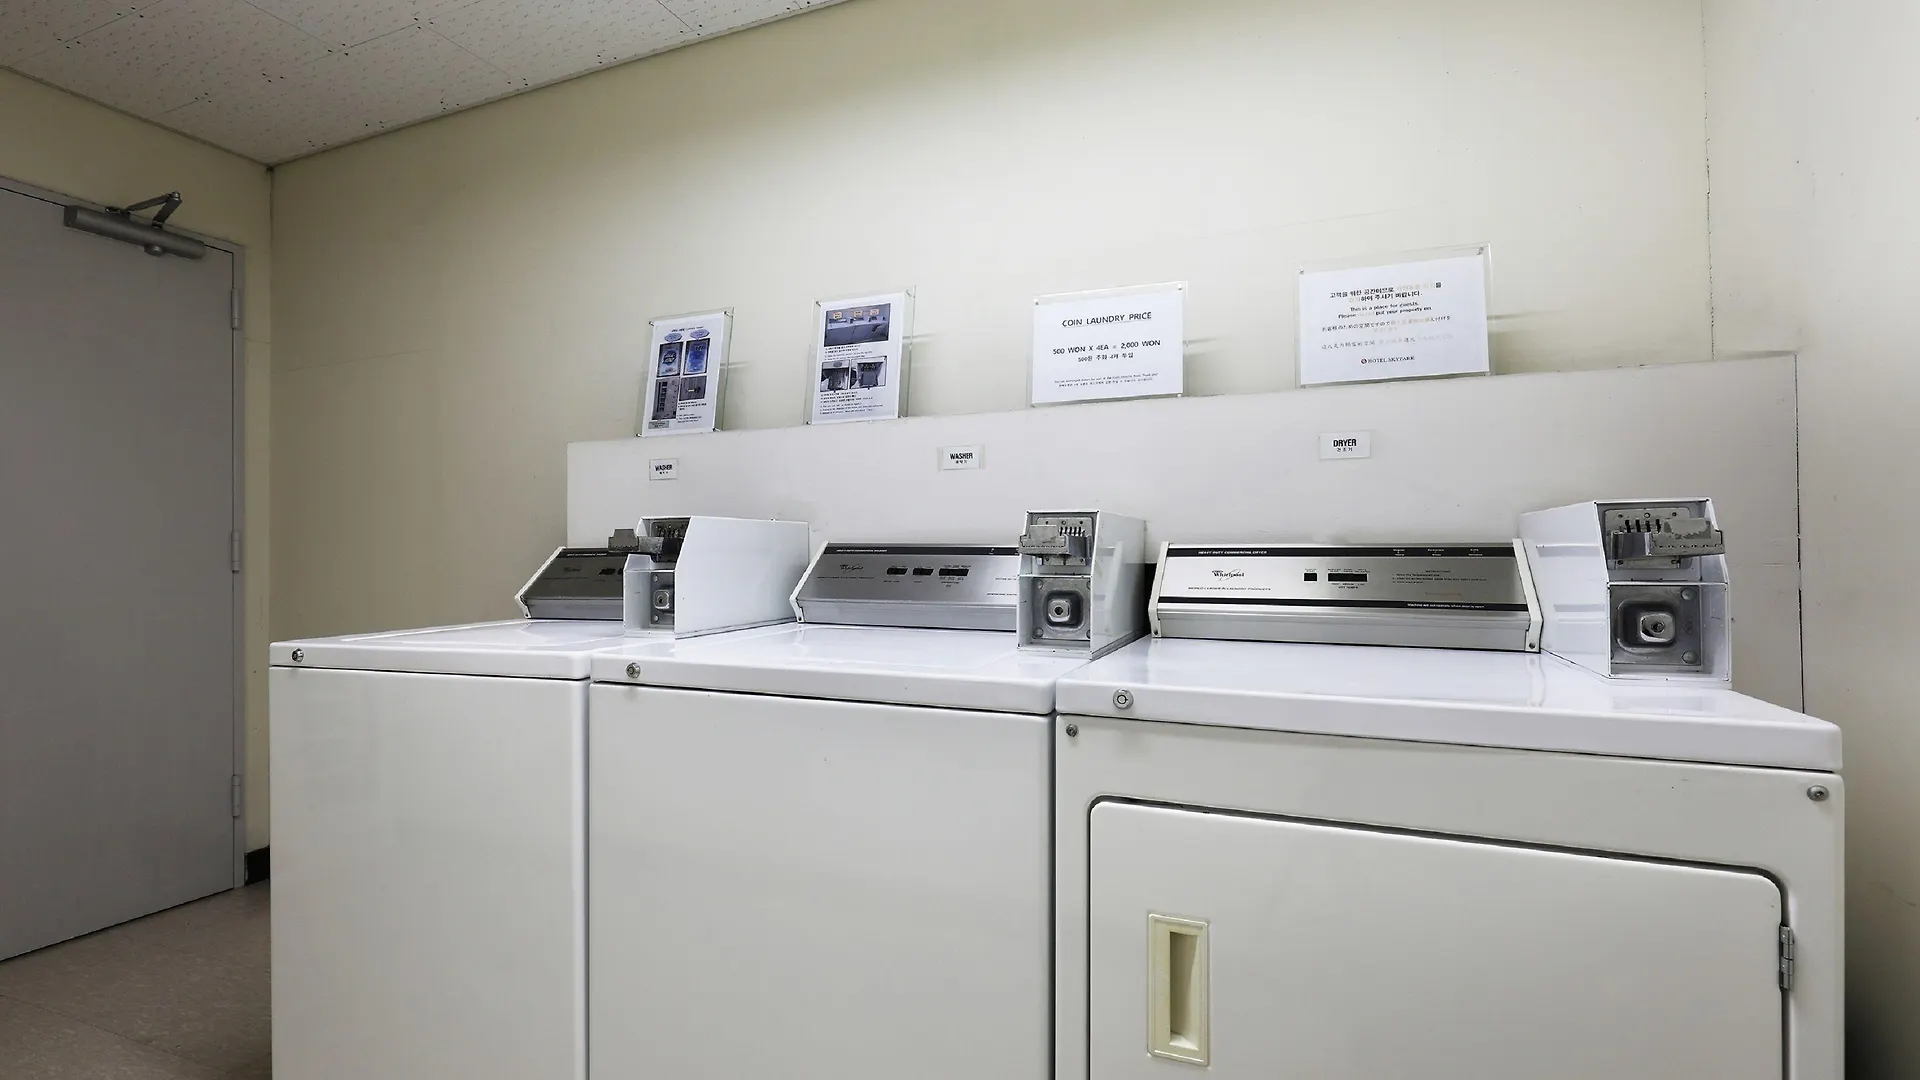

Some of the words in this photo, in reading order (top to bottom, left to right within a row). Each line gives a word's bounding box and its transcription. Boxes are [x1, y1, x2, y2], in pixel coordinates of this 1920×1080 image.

[1062, 319, 1082, 327] COIN
[1086, 314, 1125, 325] LAUNDRY
[1128, 312, 1152, 320] PRICE
[1068, 346, 1086, 354] WON
[1120, 341, 1139, 350] 2,000
[1333, 438, 1356, 447] DRYER
[950, 452, 973, 460] WASHER
